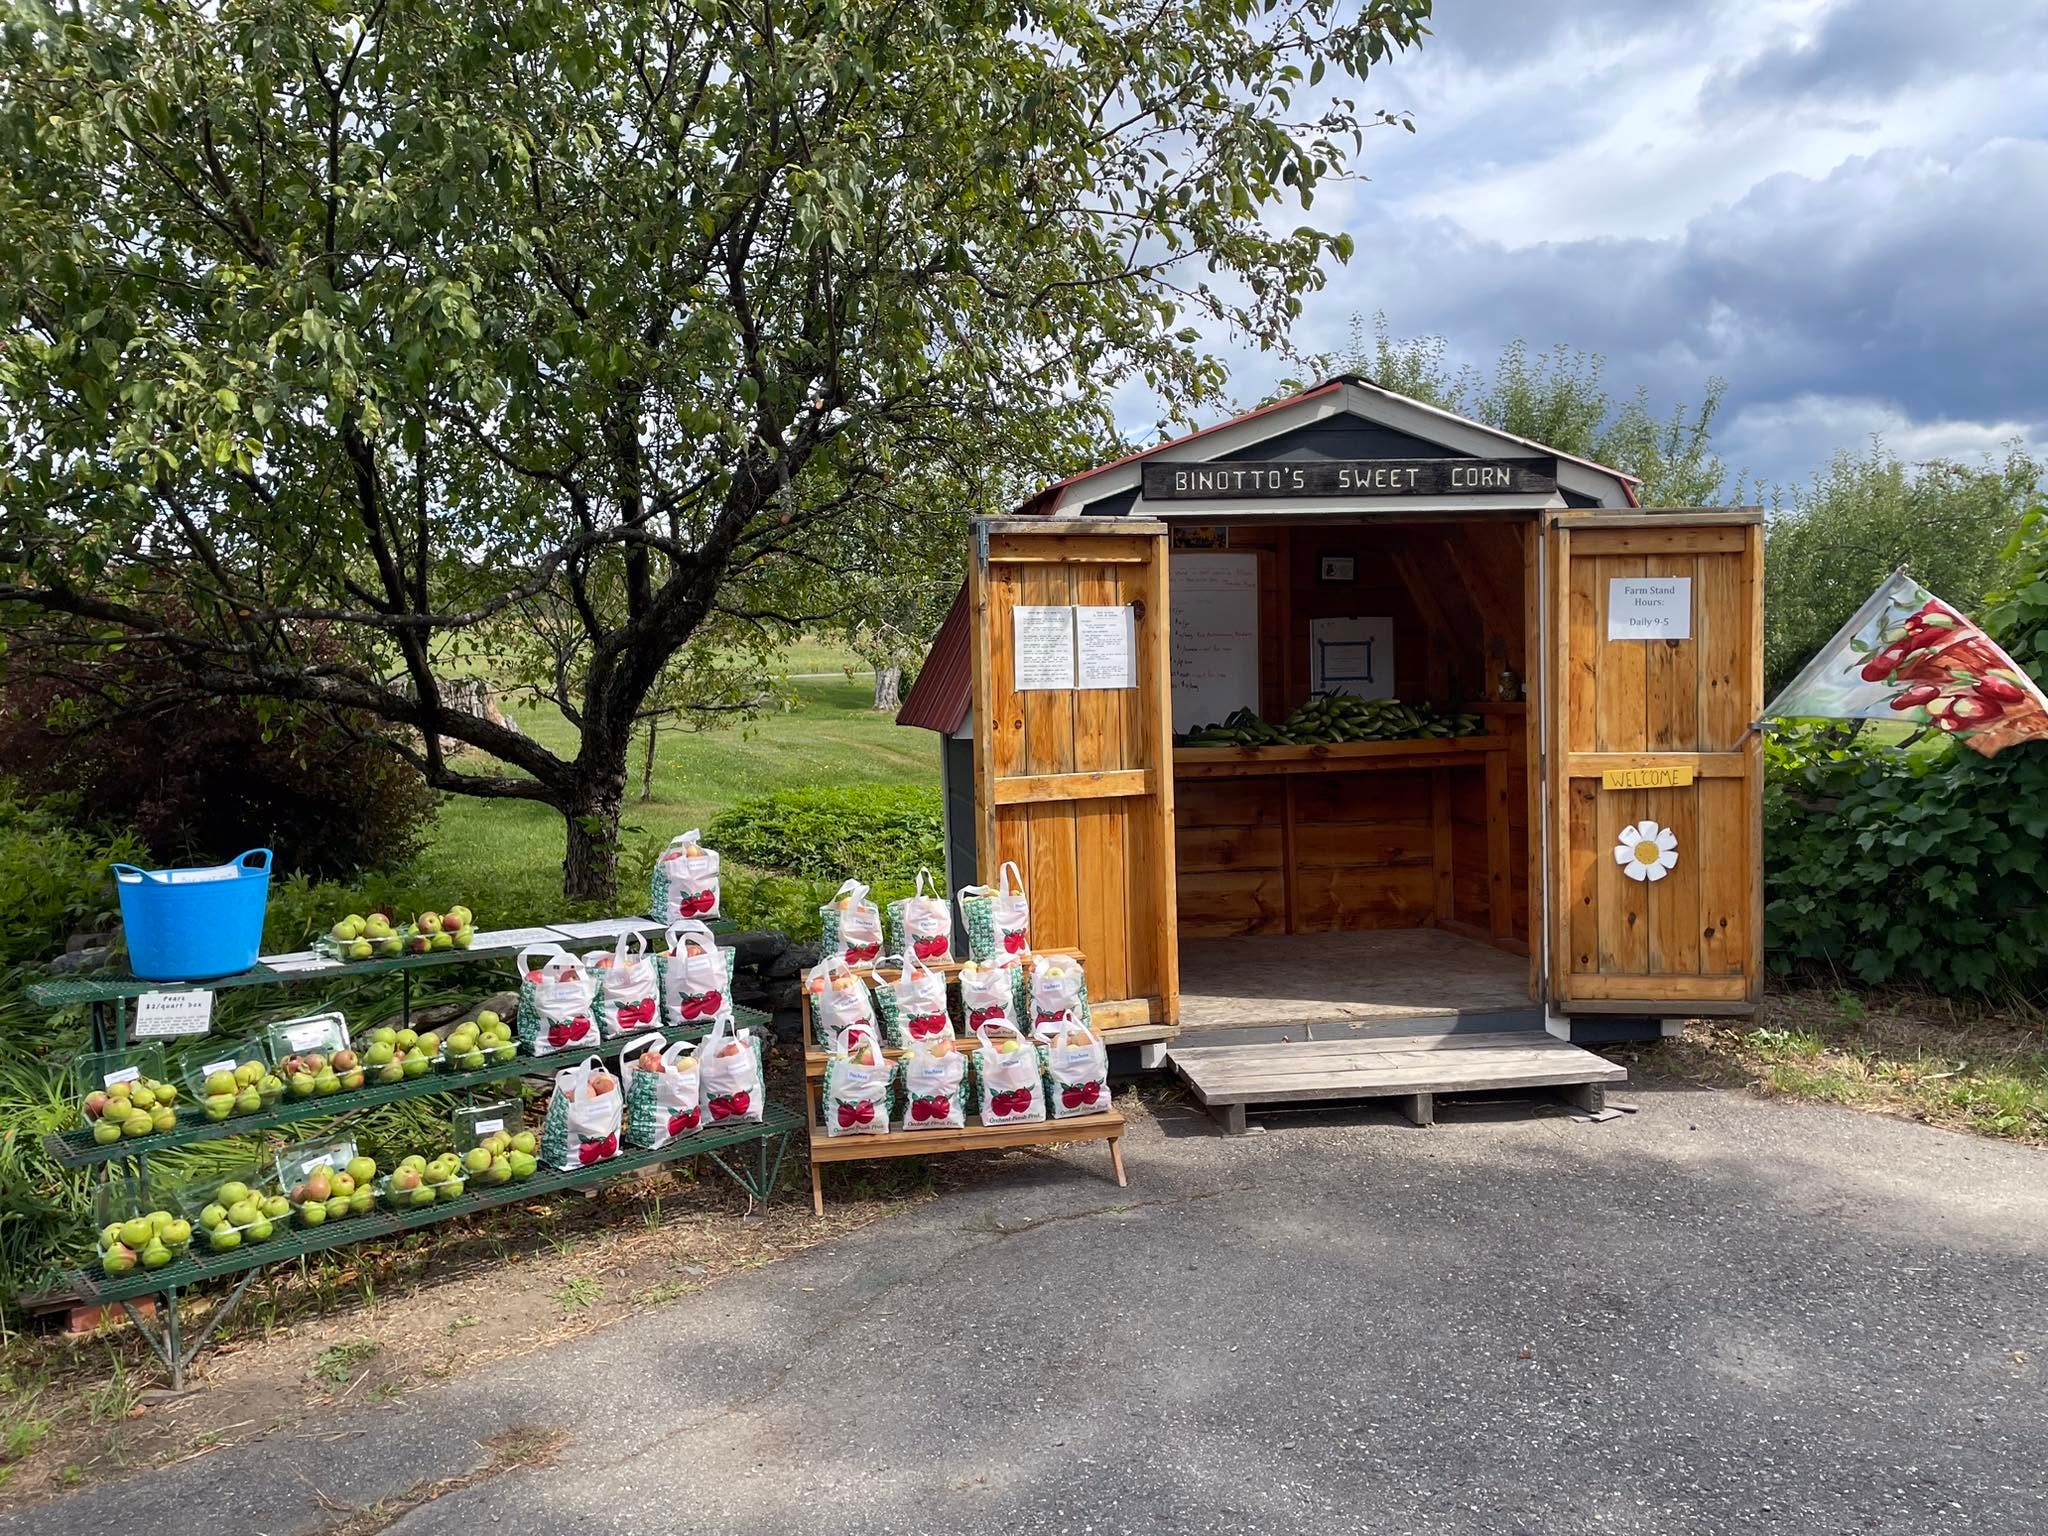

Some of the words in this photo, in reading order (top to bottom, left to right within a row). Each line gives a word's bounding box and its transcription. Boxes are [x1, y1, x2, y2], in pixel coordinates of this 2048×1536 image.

[1175, 467, 1305, 491] BINOTTO'S
[1338, 468, 1419, 489] SWEET
[1450, 467, 1511, 487] CORN
[1624, 586, 1648, 595] Farm
[1649, 586, 1675, 595] Stand
[1634, 598, 1665, 606] Hours:
[1629, 618, 1652, 627] Daily
[1654, 617, 1669, 626] 9-5
[1610, 769, 1679, 787] WELCOME
